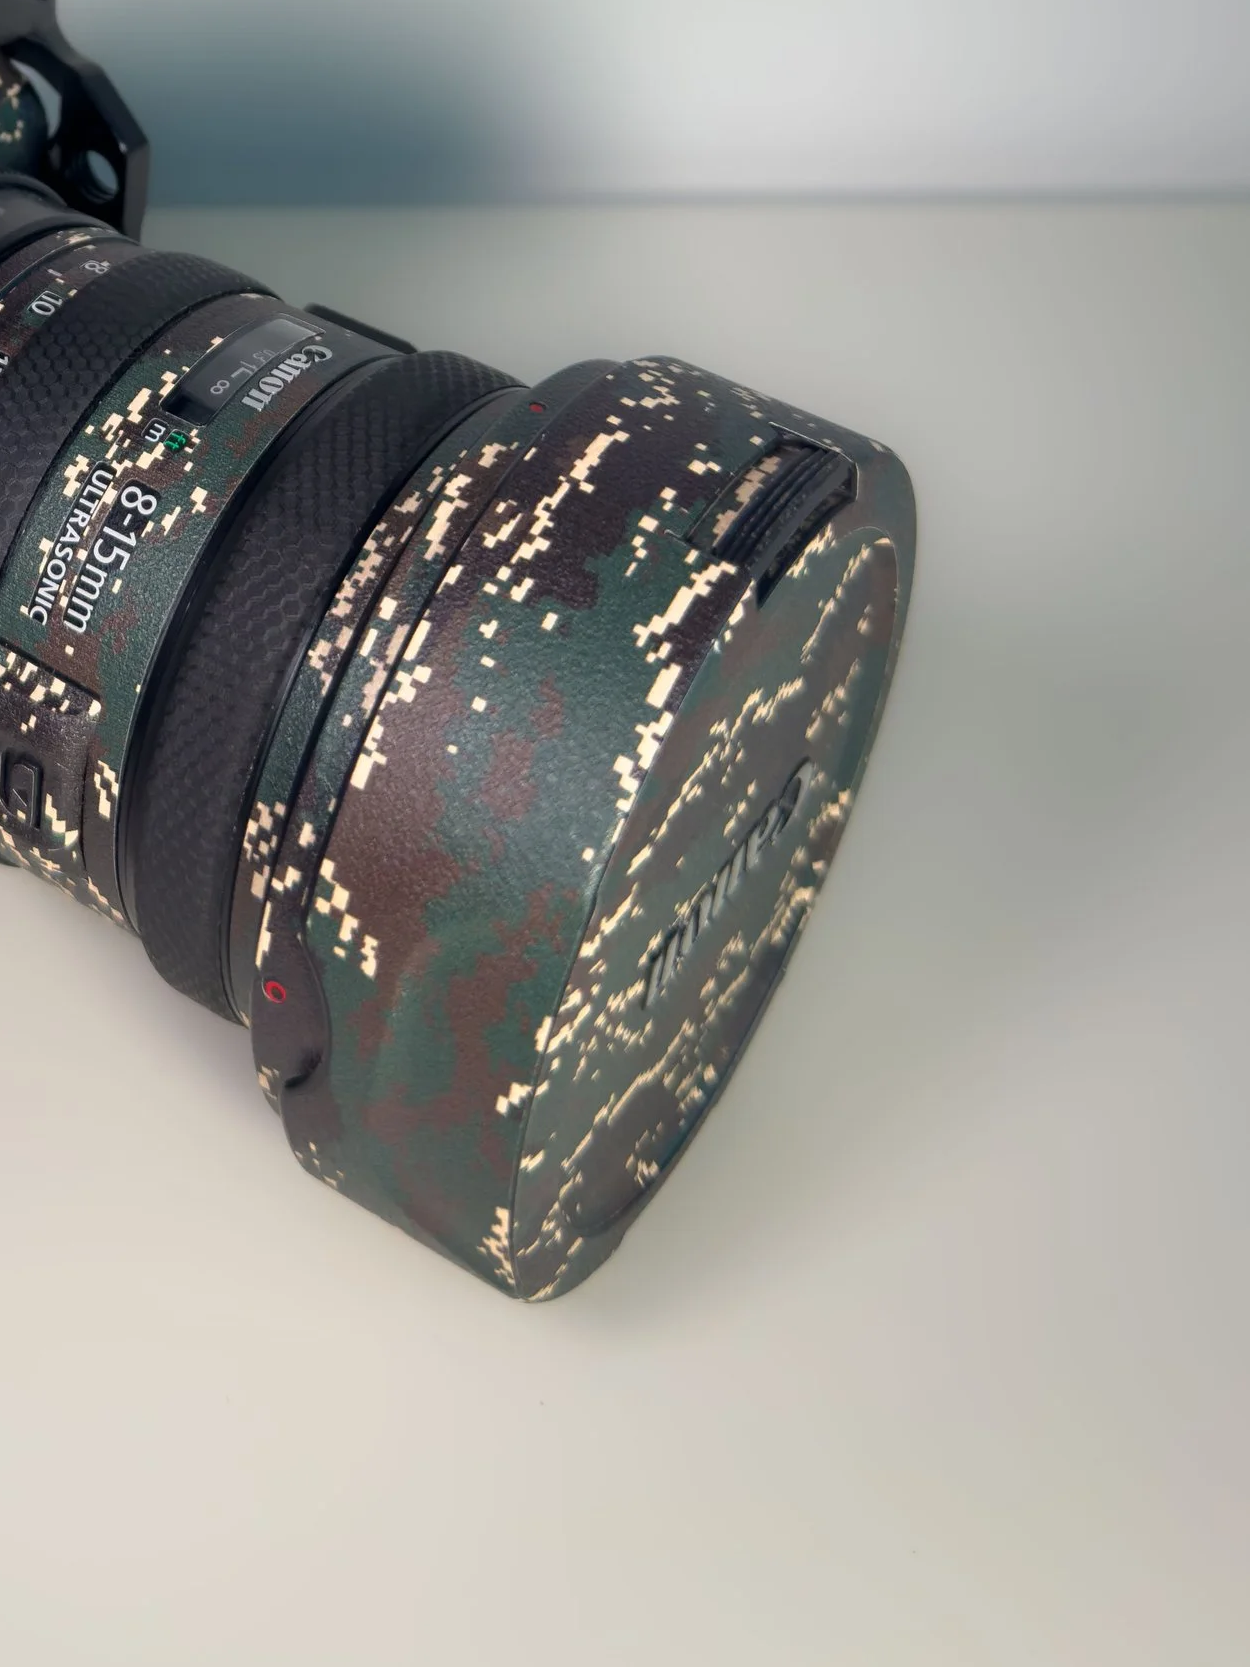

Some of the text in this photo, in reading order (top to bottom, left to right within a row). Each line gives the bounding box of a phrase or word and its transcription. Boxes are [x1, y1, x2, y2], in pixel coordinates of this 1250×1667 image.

[31, 293, 63, 316] 10
[241, 345, 333, 412] Canon
[29, 469, 114, 626] ULTRASONIC
[63, 485, 158, 633] 8-15mm
